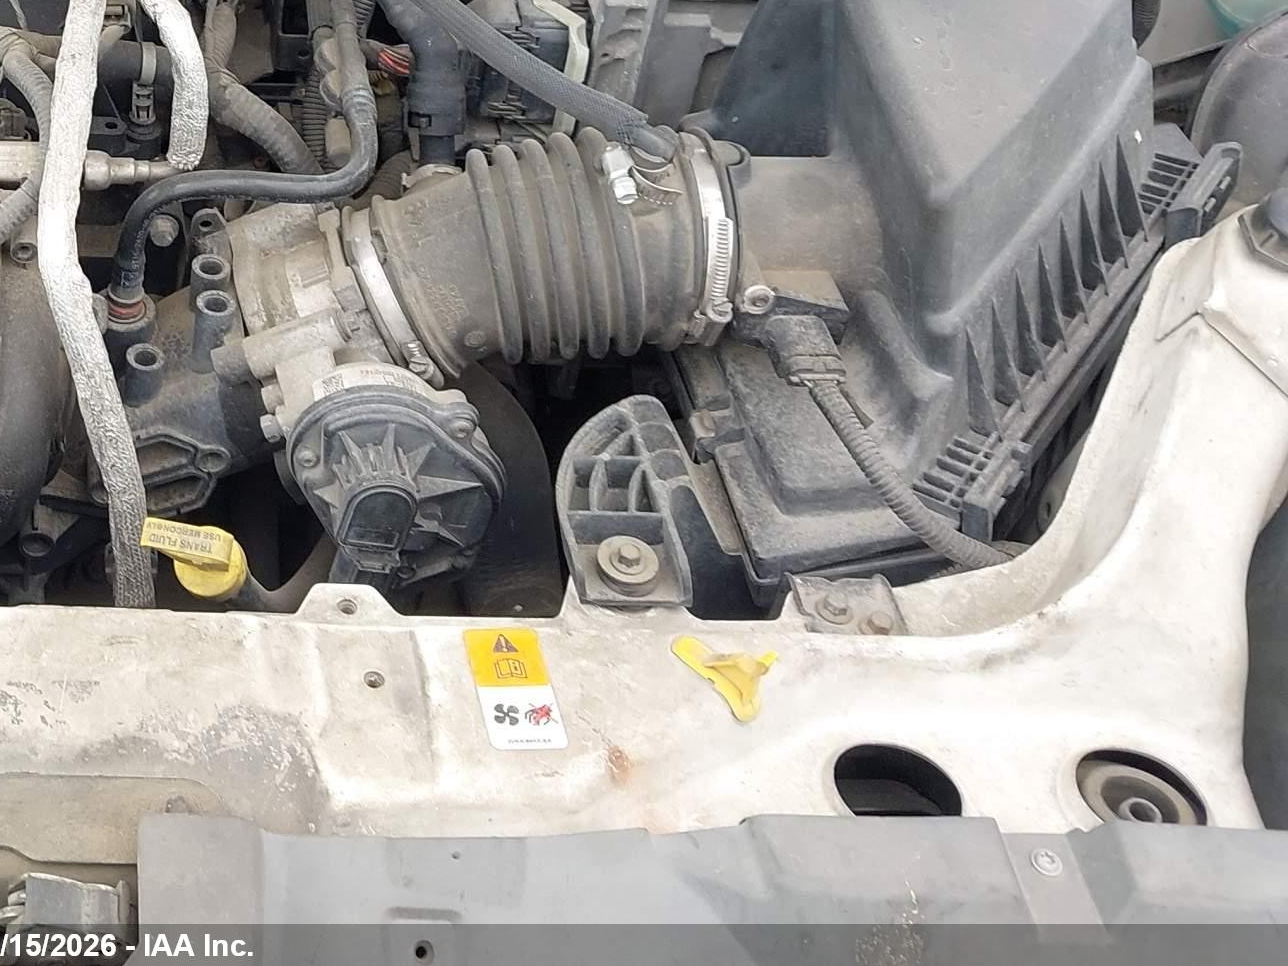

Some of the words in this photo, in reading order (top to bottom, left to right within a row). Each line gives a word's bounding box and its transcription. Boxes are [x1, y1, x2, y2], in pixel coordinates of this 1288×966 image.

[149, 533, 178, 547] FLUID
[202, 533, 222, 543] USE
[179, 542, 213, 554] TRANS
